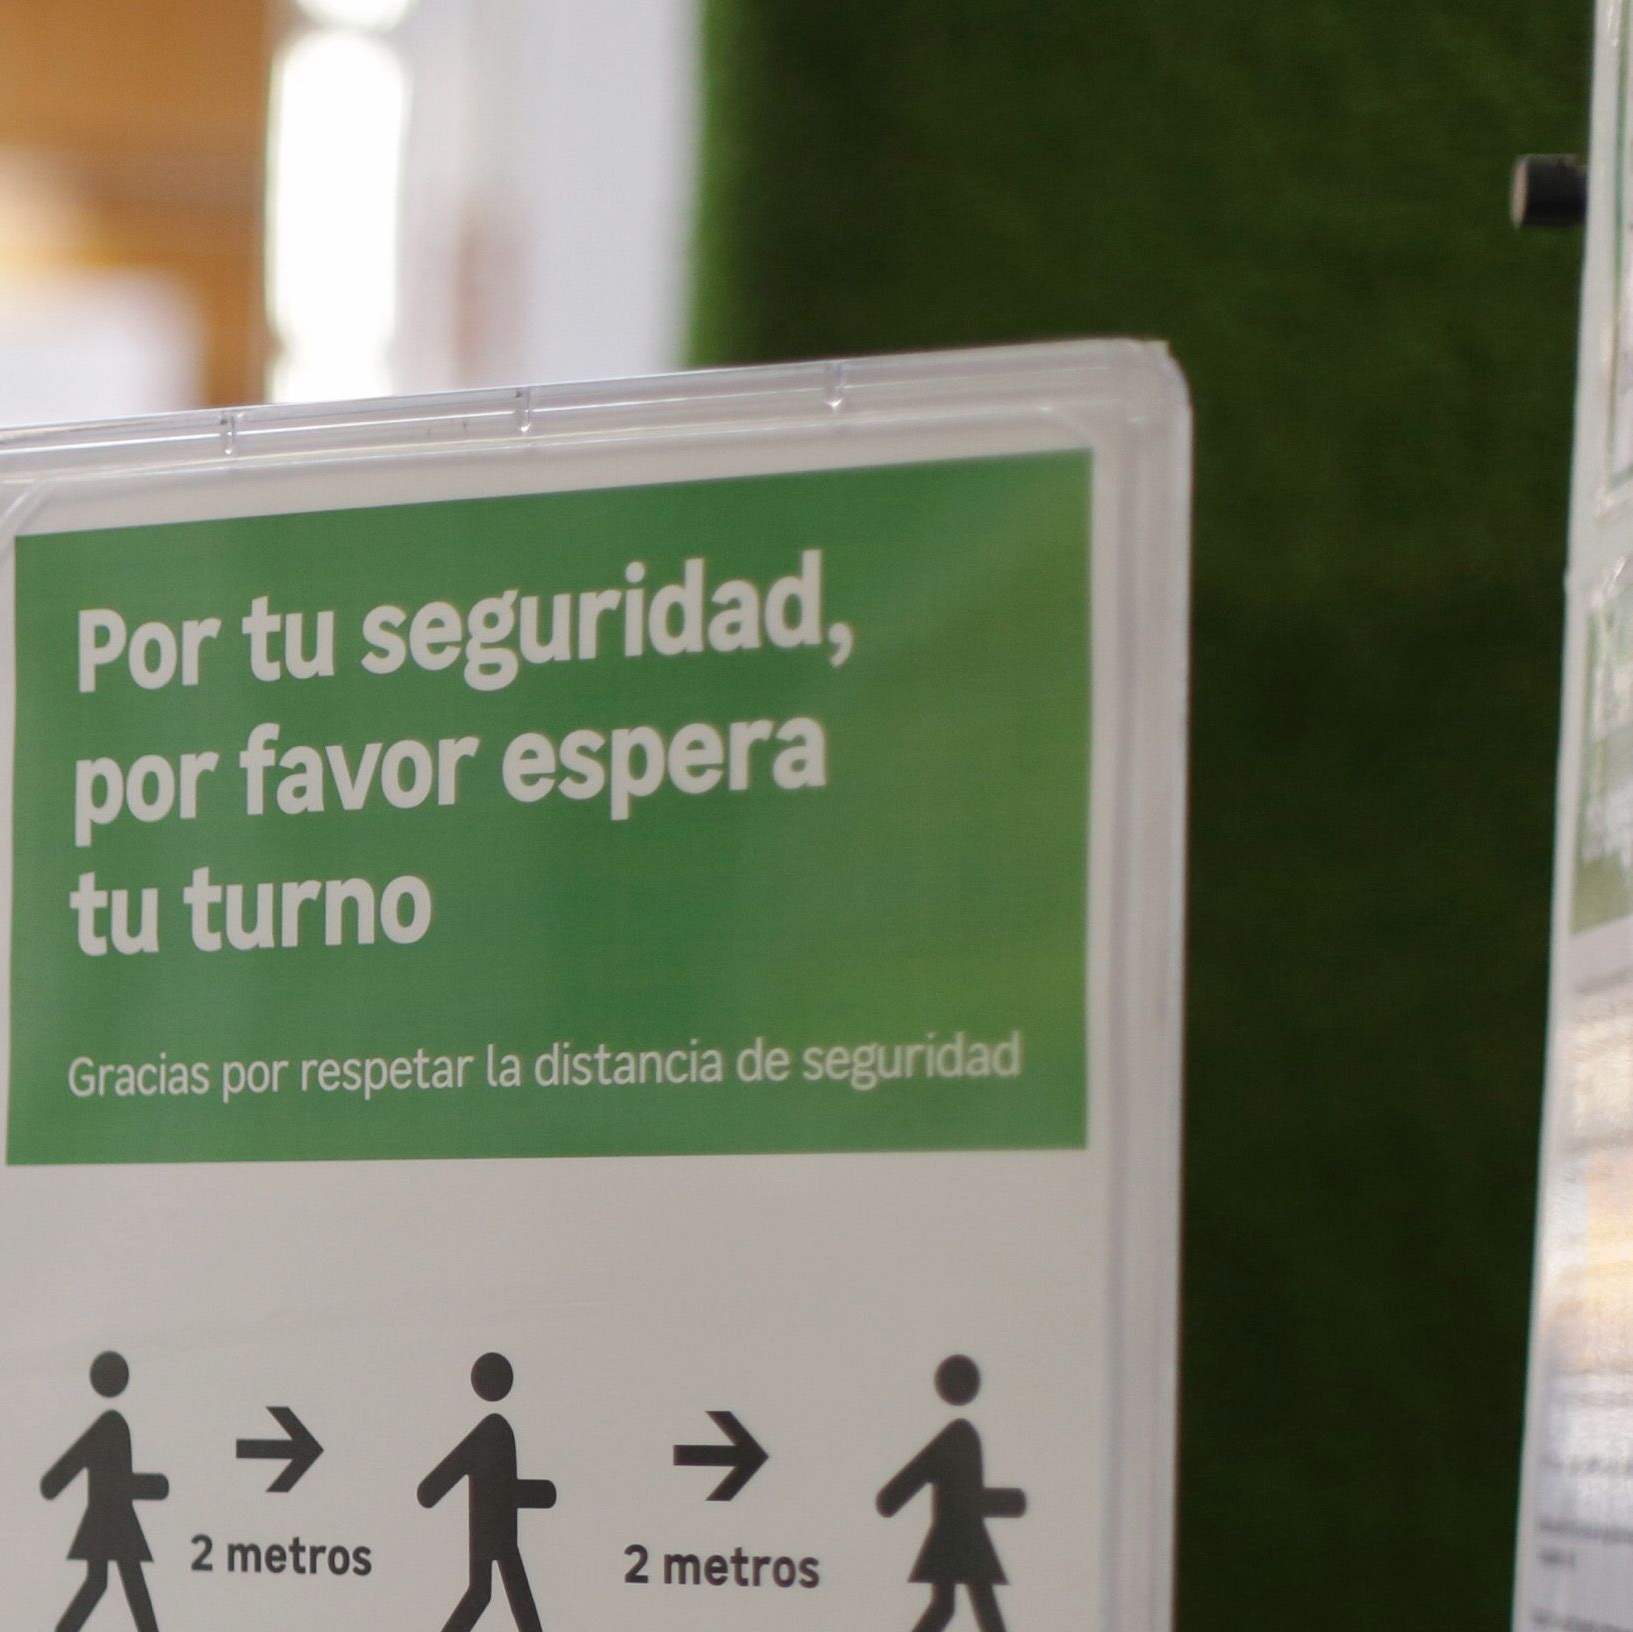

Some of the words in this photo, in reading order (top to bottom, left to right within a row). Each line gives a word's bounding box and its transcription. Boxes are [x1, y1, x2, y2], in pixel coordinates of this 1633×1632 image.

[77, 606, 223, 693] Por
[240, 594, 336, 682] tu
[360, 548, 854, 692] seguridad,
[74, 749, 221, 848] por
[238, 721, 481, 816] favor
[501, 715, 827, 821] espera
[69, 870, 160, 957] tu
[182, 864, 434, 953] turno
[67, 1054, 212, 1098] Gracias
[222, 1060, 290, 1104] por
[301, 1047, 475, 1101] respetar
[486, 1043, 522, 1088] la
[534, 1041, 724, 1087] distancia
[736, 1036, 791, 1083] de
[803, 1029, 1022, 1091] seguridad
[189, 1532, 214, 1573] 2
[226, 1535, 373, 1577] metros
[623, 1543, 650, 1585] 2
[663, 1546, 822, 1590] metros
